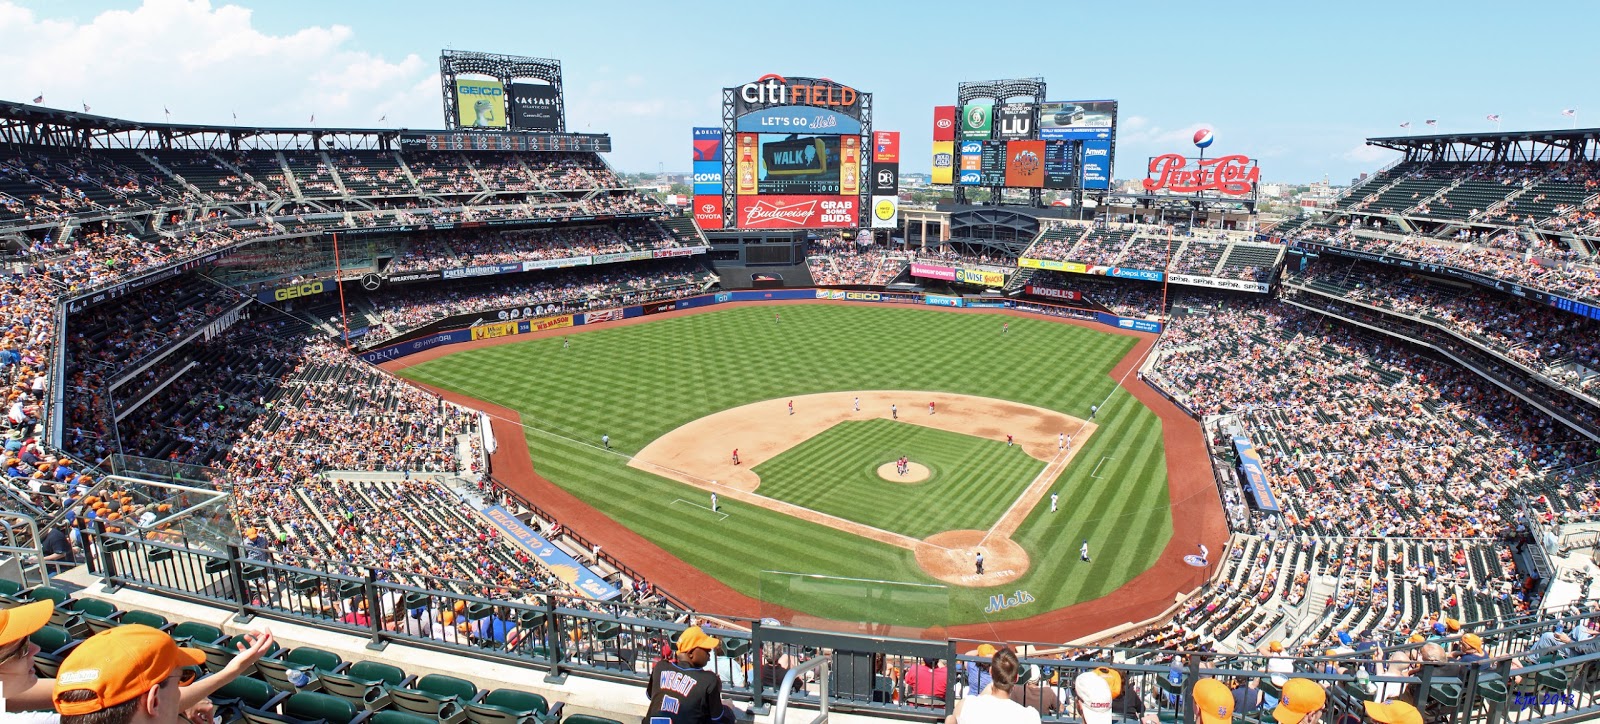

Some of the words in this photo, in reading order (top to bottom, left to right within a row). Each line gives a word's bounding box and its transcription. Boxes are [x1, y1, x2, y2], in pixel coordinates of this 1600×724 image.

[459, 85, 502, 96] GEICO
[791, 85, 857, 106] FIELD
[514, 96, 556, 106] CAESARS
[761, 117, 789, 126] LET'S
[793, 117, 807, 126] GO
[809, 115, 837, 129] Mets
[1001, 115, 1030, 134] LIU
[773, 151, 804, 165] WALK
[1085, 148, 1108, 156] Amway
[694, 173, 721, 182] GOYA
[820, 201, 853, 209] GRAB
[744, 206, 815, 219] Budweiser
[820, 214, 852, 223] BUDS
[568, 257, 588, 265] Services
[936, 270, 955, 278] DONUTS
[966, 272, 983, 282] WISE
[1121, 270, 1139, 278] pepsi
[274, 281, 324, 302] GEICO
[1032, 286, 1075, 299] MODELL'S
[658, 303, 676, 312] verizon
[423, 334, 452, 347] HYUNDAI
[369, 347, 400, 362] DELTA
[487, 508, 529, 540] WELCOME
[525, 537, 543, 549] TO
[984, 589, 1035, 614] Mets
